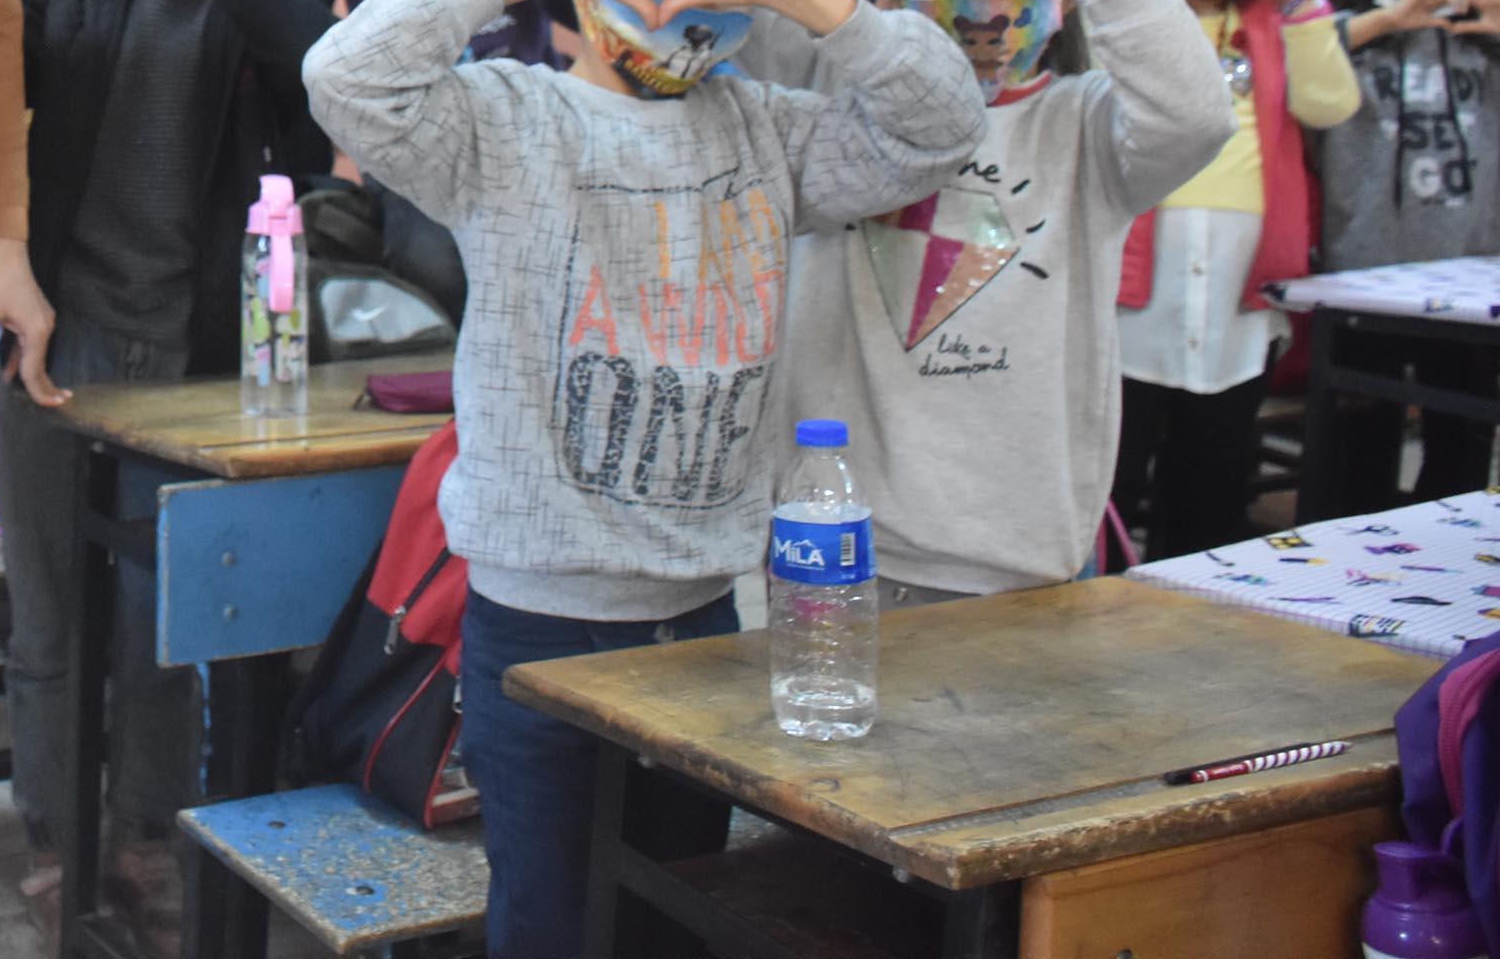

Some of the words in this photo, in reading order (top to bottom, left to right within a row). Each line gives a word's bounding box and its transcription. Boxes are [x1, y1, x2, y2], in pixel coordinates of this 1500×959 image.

[569, 264, 621, 356] A
[918, 346, 1012, 380] diamond
[563, 350, 765, 502] ONE
